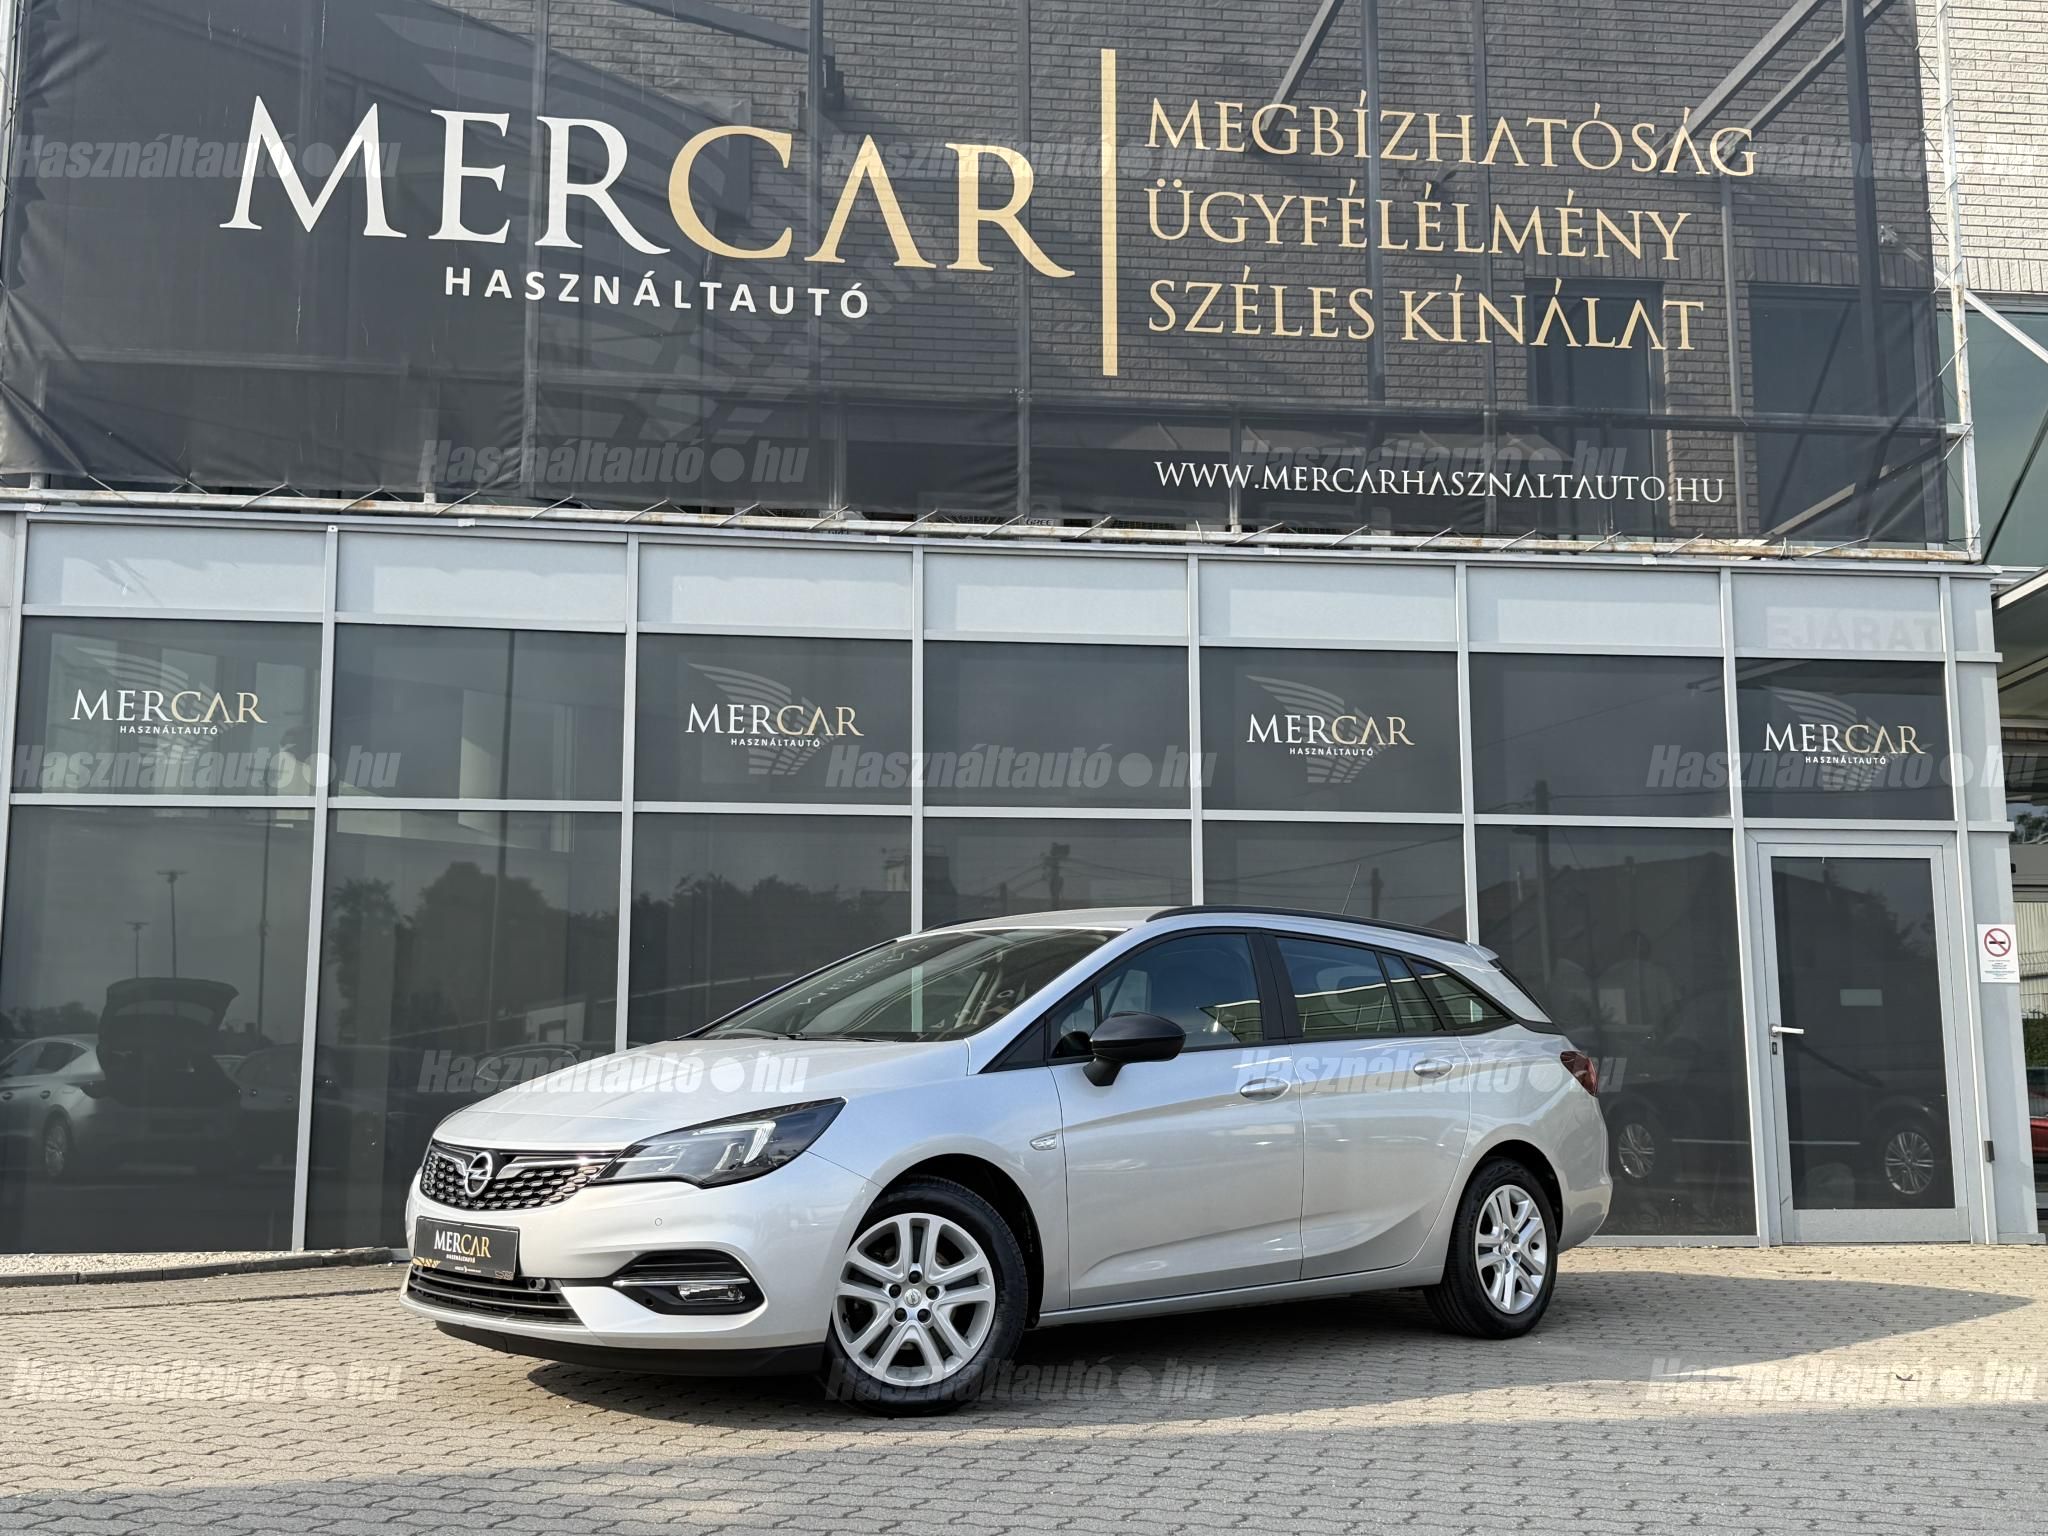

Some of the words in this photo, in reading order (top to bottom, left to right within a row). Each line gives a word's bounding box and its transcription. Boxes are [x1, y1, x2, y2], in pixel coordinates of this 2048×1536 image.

[1144, 88, 1758, 178] MEGBÍZHATÓSÁG
[220, 96, 1075, 279] MERCAR
[1144, 177, 1692, 261] ÜGYFÉLÉLMÉNY
[445, 266, 868, 319] HASZNÁLTAUTÓ
[1148, 265, 1375, 339] SZÉLES
[1400, 274, 1704, 351] KÍNÁLAT
[1154, 461, 1725, 503] WWW.MERCARHASZNALTAUTO.HU
[70, 689, 268, 723] MERCAR
[685, 703, 865, 736] MERCAR
[119, 724, 218, 735] HASZNÁLTAUTÓ
[730, 737, 821, 748] HASZNÁLTAUTÓ
[1246, 714, 1415, 745] MERCAR
[1763, 723, 1926, 754] MERCAR
[1289, 747, 1374, 756] HASZNÁLTAUTÓ
[1805, 755, 1887, 765] HASZNÁLTAUTÓ
[433, 1229, 492, 1258] MERCAR
